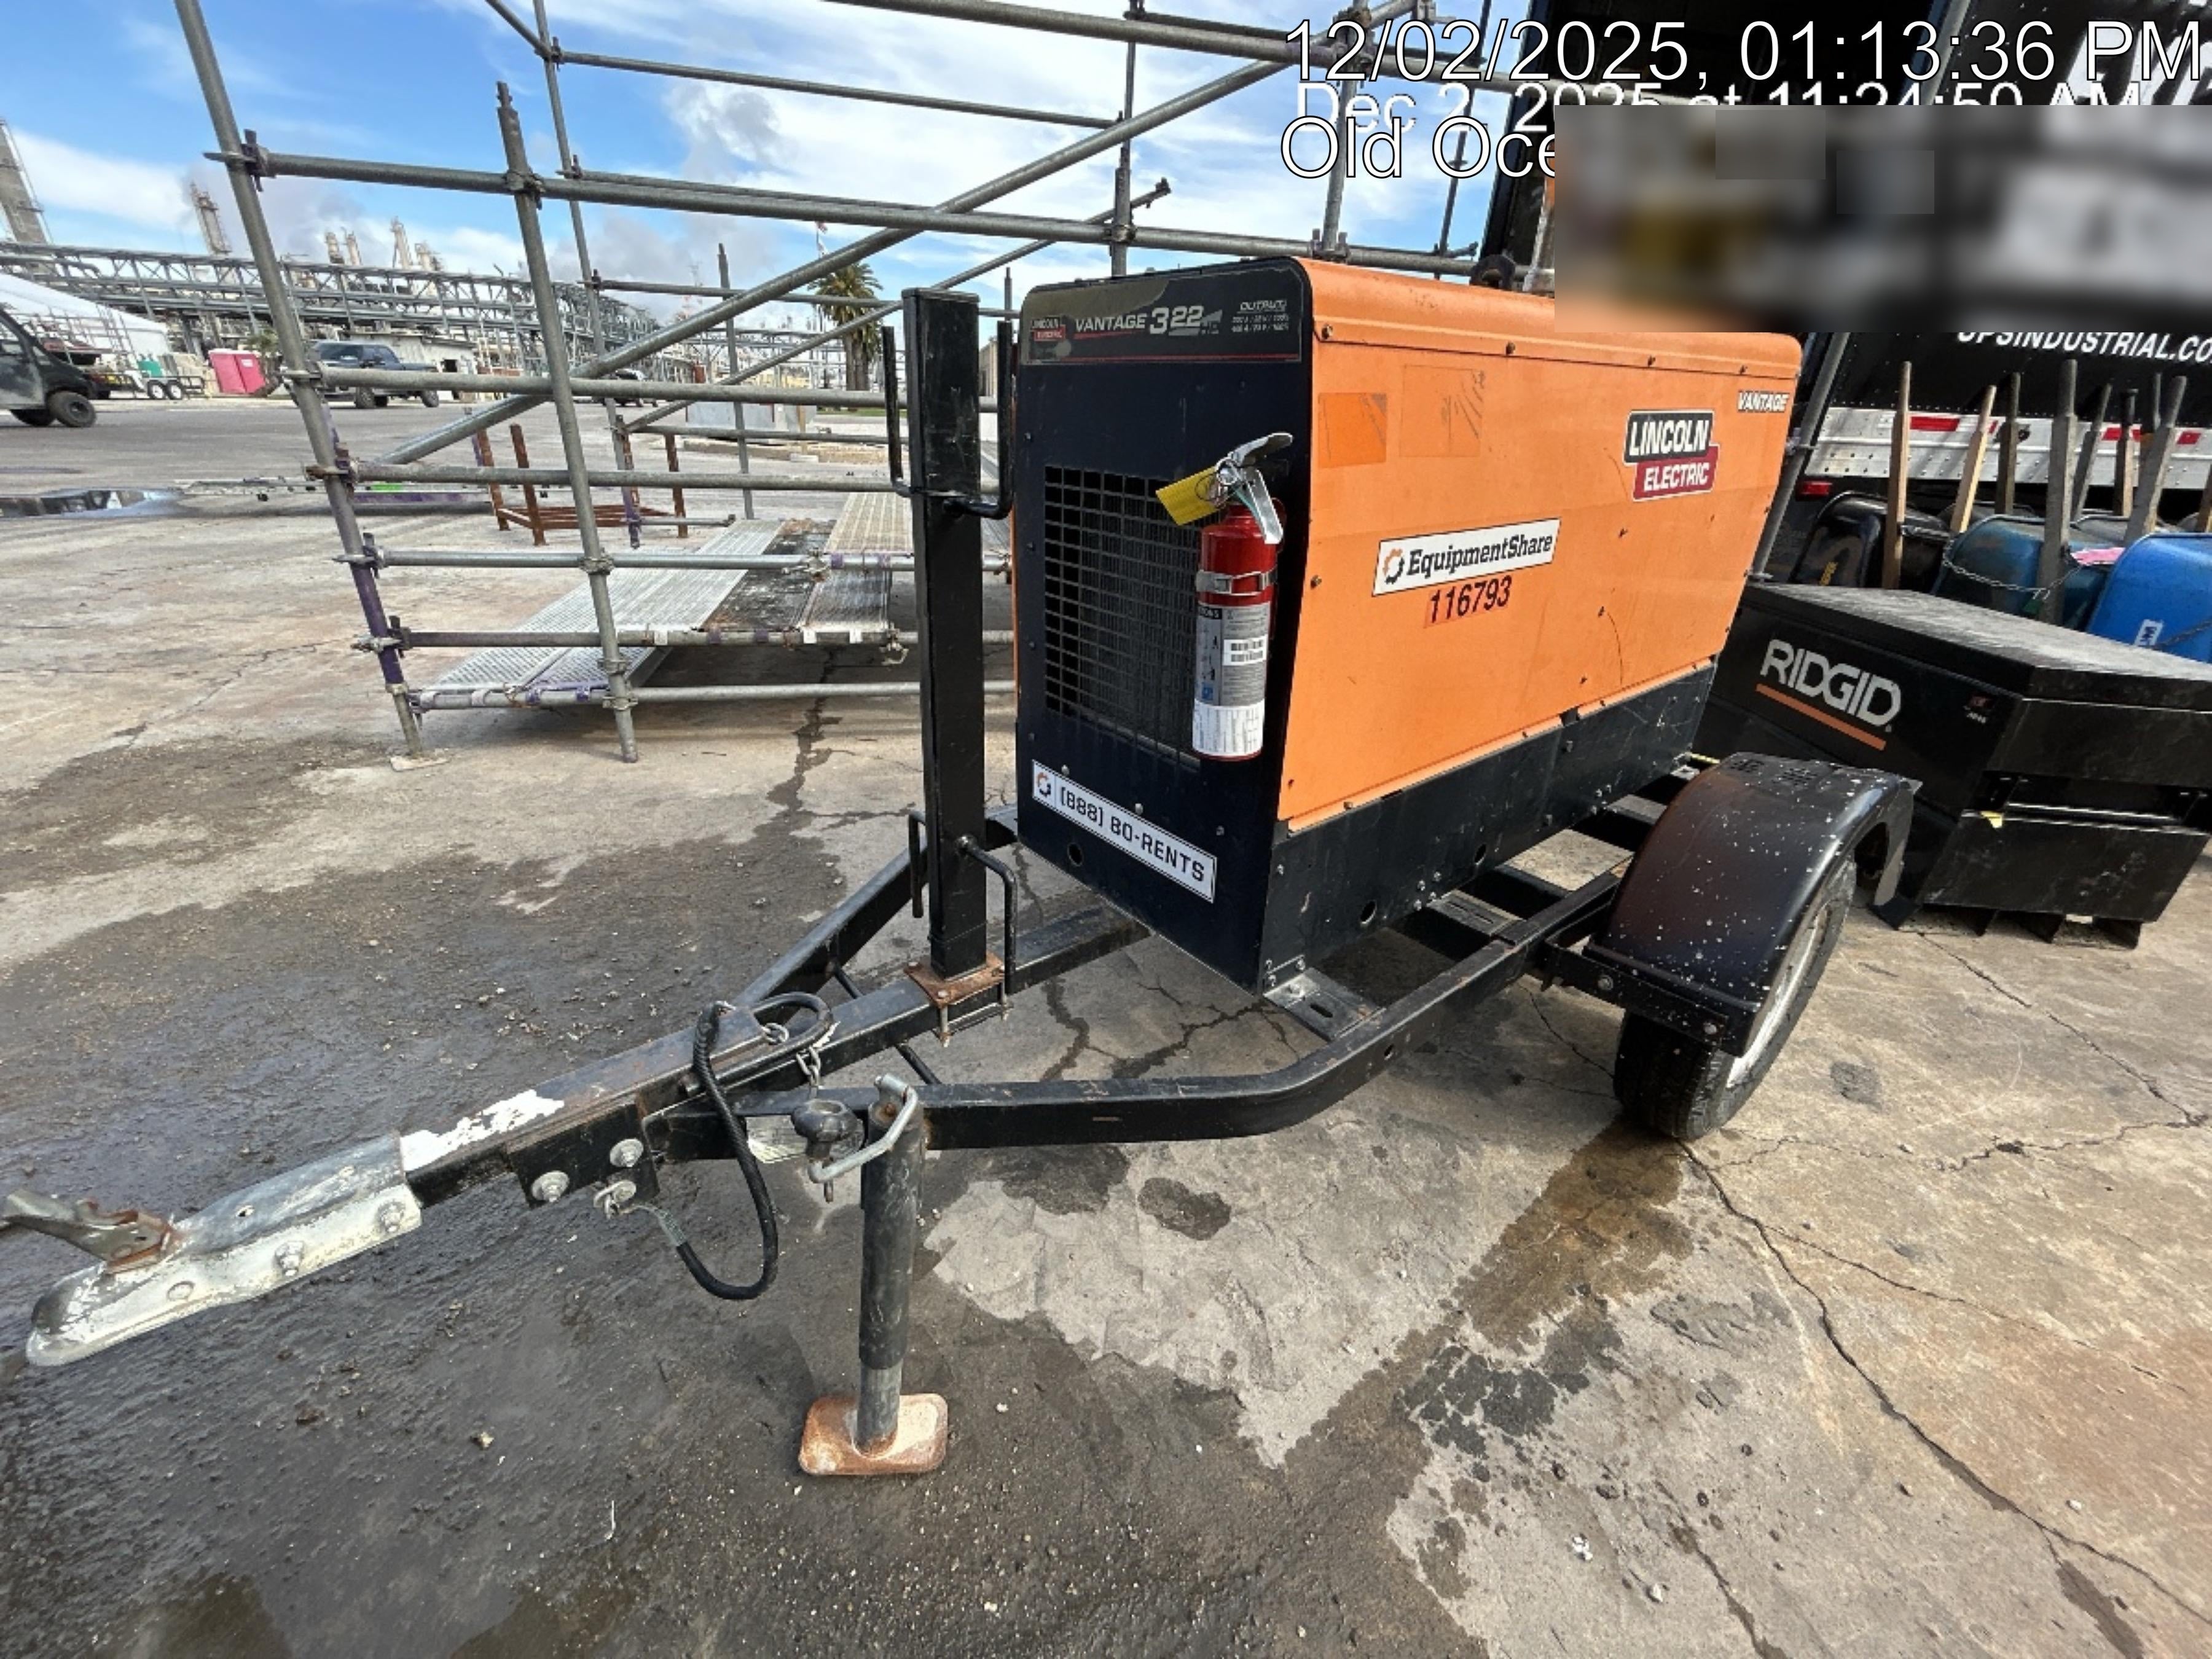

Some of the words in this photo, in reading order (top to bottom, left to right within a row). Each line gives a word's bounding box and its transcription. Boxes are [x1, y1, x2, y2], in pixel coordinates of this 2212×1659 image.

[1075, 313, 1148, 332] VANTAGE
[1149, 305, 1205, 335] 322
[1738, 391, 1789, 412] VANTAGE
[1629, 420, 1710, 456] LINCOLN
[1644, 463, 1709, 492] ELECTRIC
[1407, 535, 1553, 579] EquipmentShare
[1430, 575, 1512, 624] 116793
[1760, 638, 1901, 726] RIDGID
